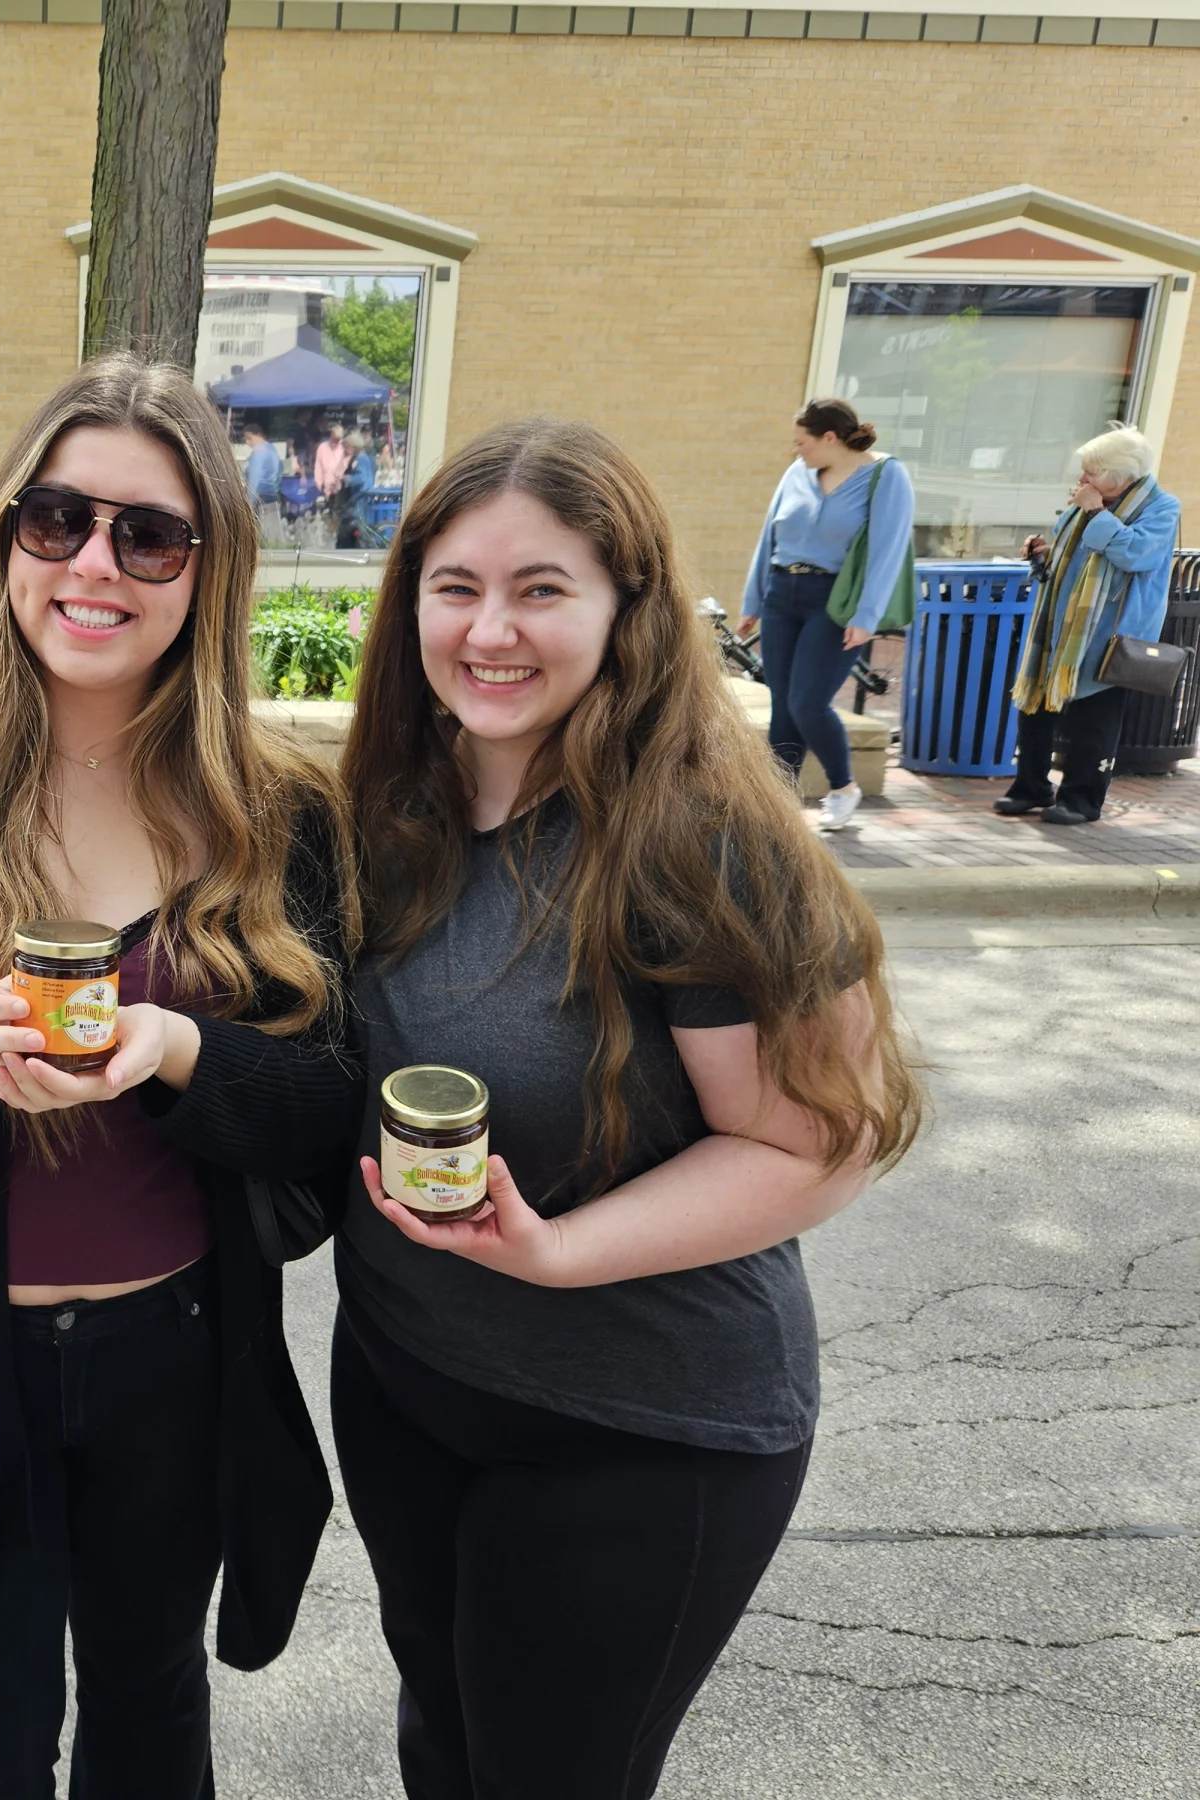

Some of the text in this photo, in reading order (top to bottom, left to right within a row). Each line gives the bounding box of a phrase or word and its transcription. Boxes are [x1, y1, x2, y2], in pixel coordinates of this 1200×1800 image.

[65, 1002, 98, 1020] Rollicking
[416, 1167, 451, 1185] Rollicking
[435, 1192, 465, 1205] Pepper Jam
